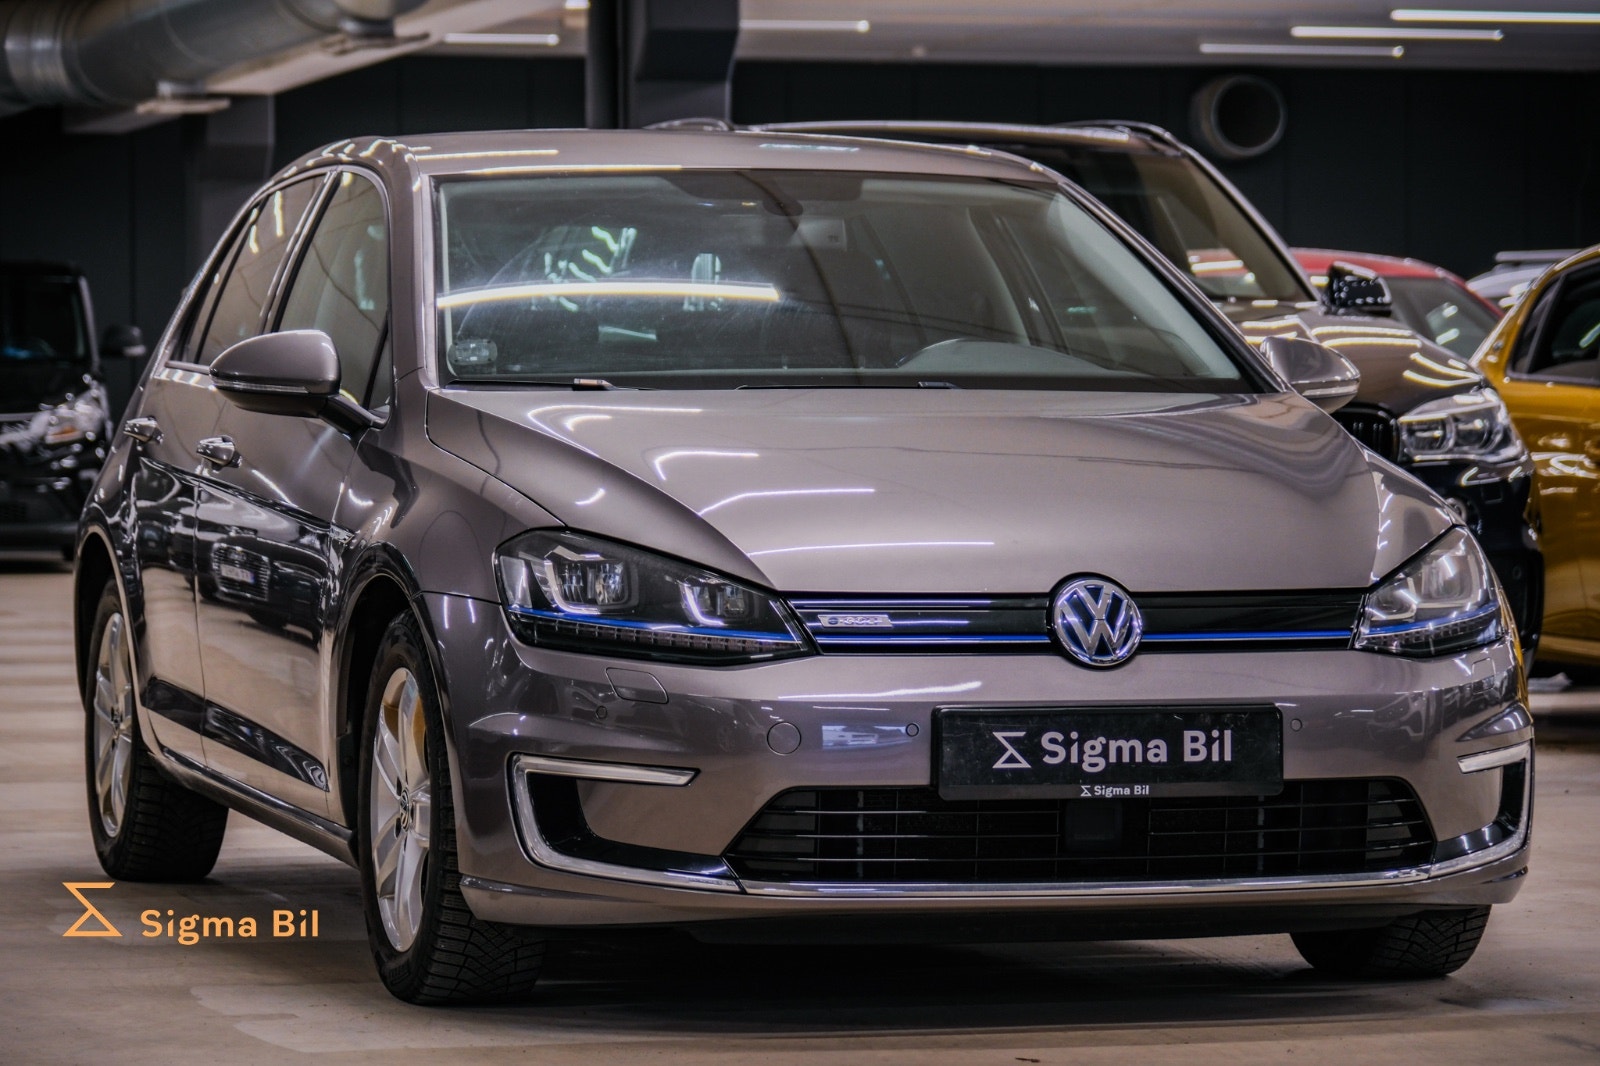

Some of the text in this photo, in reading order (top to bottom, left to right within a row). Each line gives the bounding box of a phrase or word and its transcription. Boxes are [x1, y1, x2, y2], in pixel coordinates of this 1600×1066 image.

[1040, 729, 1232, 773] Sigma Bil
[1094, 785, 1150, 798] Sigma Bil
